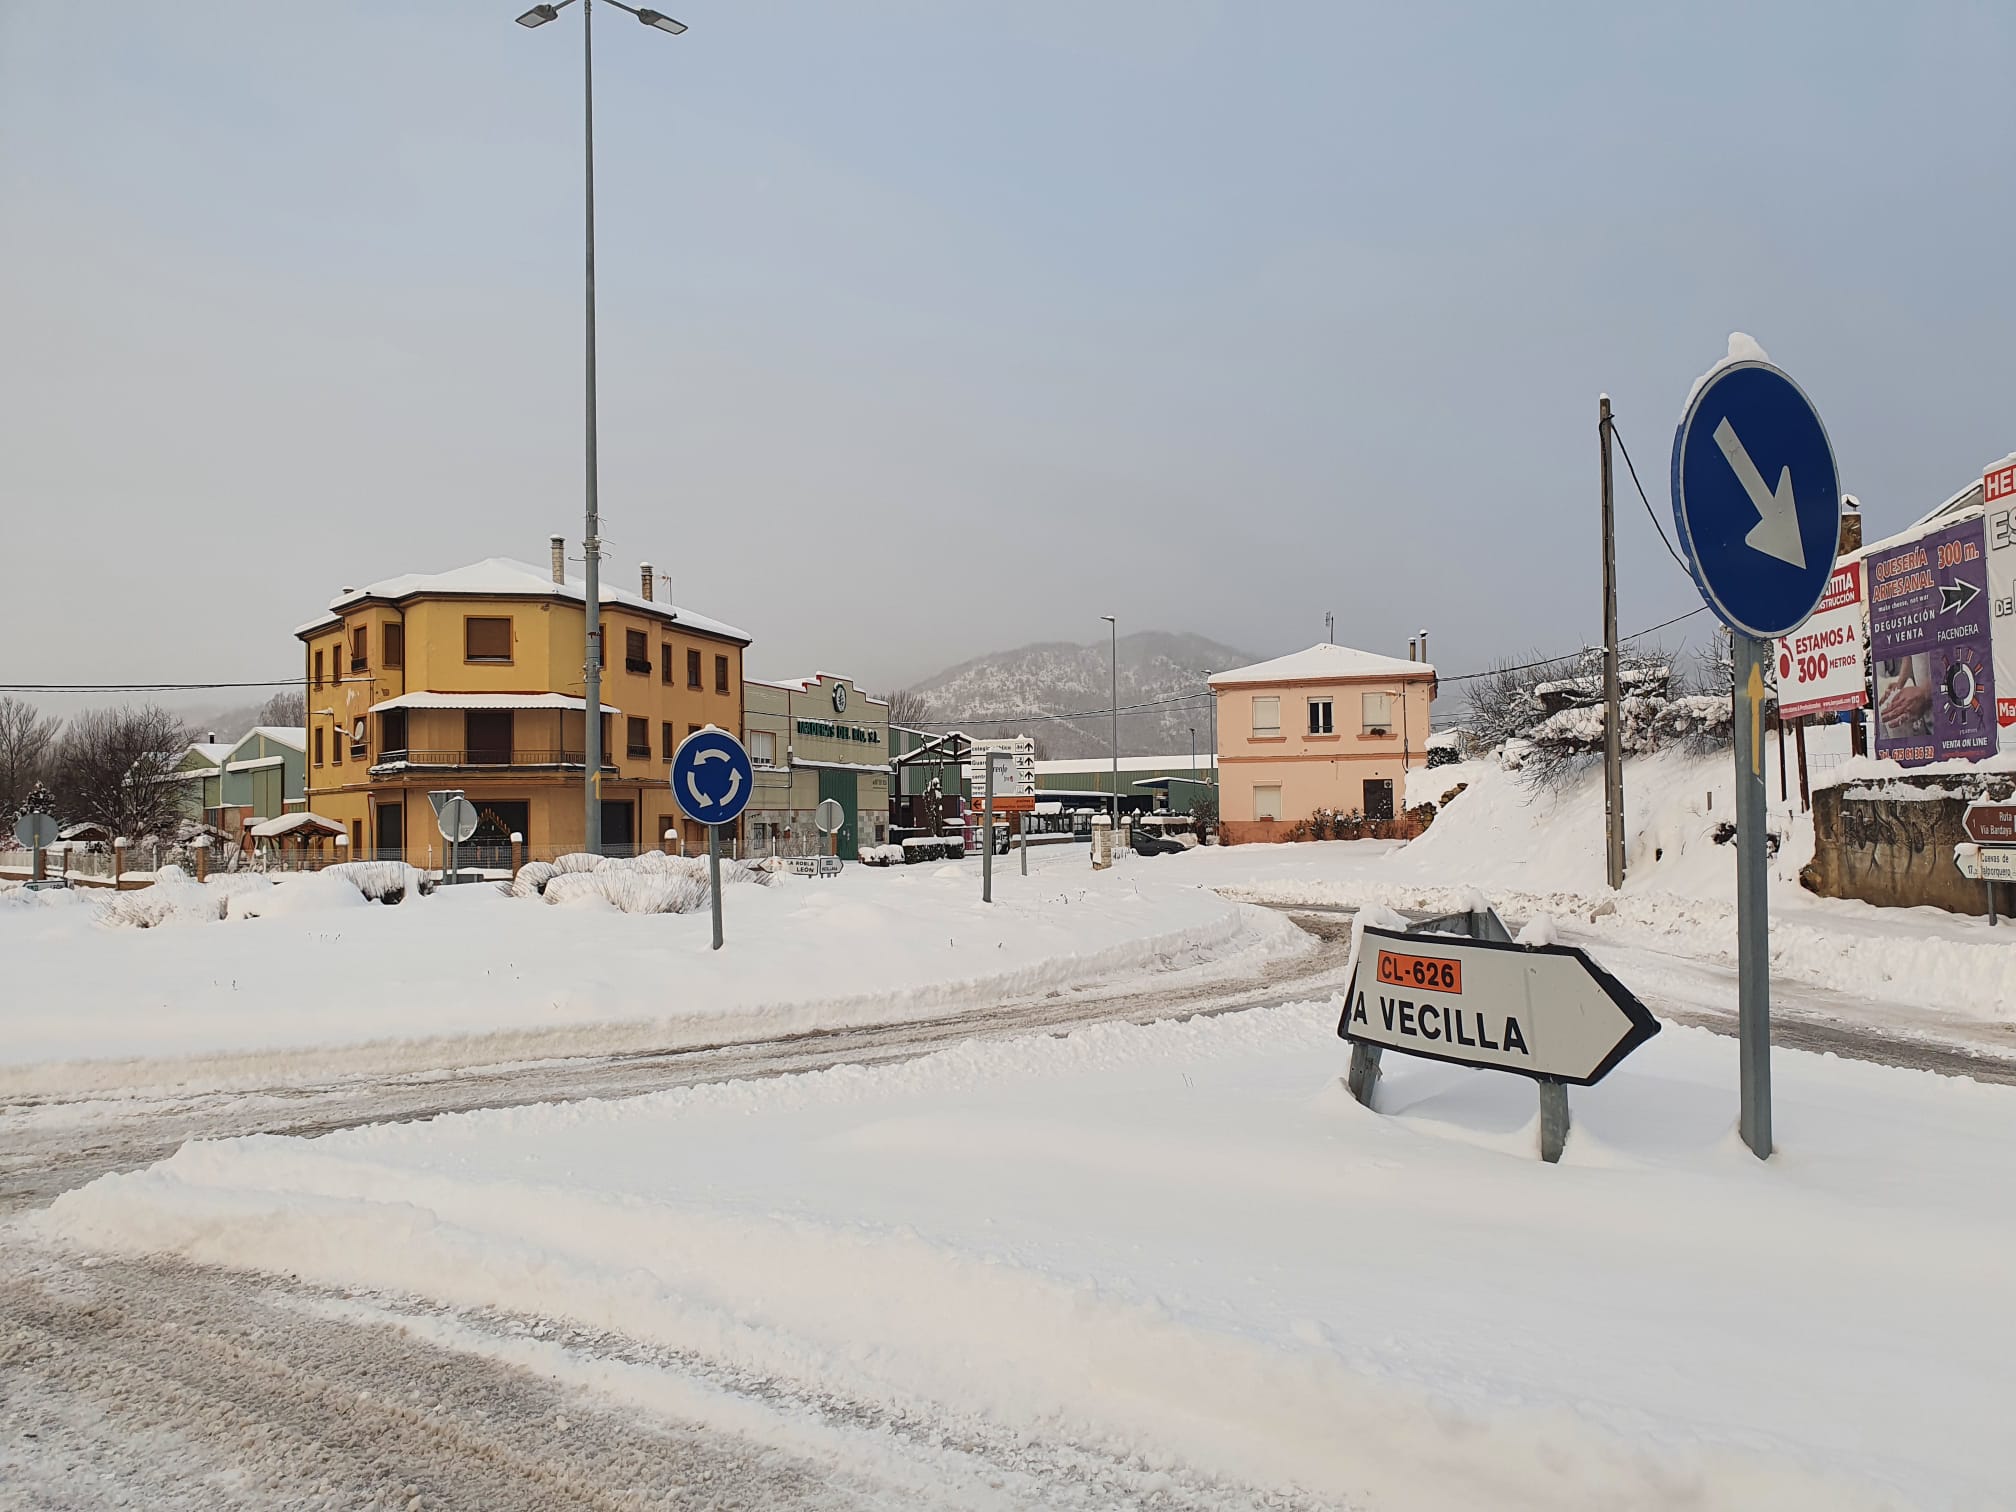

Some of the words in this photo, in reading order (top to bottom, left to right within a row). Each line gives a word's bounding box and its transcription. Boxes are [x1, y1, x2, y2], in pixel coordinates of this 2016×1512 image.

[1987, 468, 2016, 499] HE
[1875, 546, 1928, 582] QUESERÍA
[1937, 540, 1962, 569] 300
[1963, 542, 1980, 562] m.
[1872, 569, 1934, 603] ARTESANAL
[1995, 597, 2012, 618] DE
[1874, 609, 1936, 633] DEGUSTACIÓN
[1937, 624, 1979, 642] FACENDERA
[1795, 627, 1843, 655] ESTAMOS
[1846, 624, 1855, 643] A
[1886, 634, 1892, 645] Y
[1895, 627, 1924, 643] VENTA
[1797, 652, 1828, 684] 300
[1829, 654, 1856, 670] METROS
[1999, 700, 2016, 718] Ma
[1942, 739, 1961, 750] VENTA
[1961, 738, 1972, 748] ON
[1999, 811, 2012, 822] Ruta
[2001, 853, 2009, 863] de
[1381, 956, 1455, 990] CL-626
[1380, 996, 1530, 1056] VECILLA
